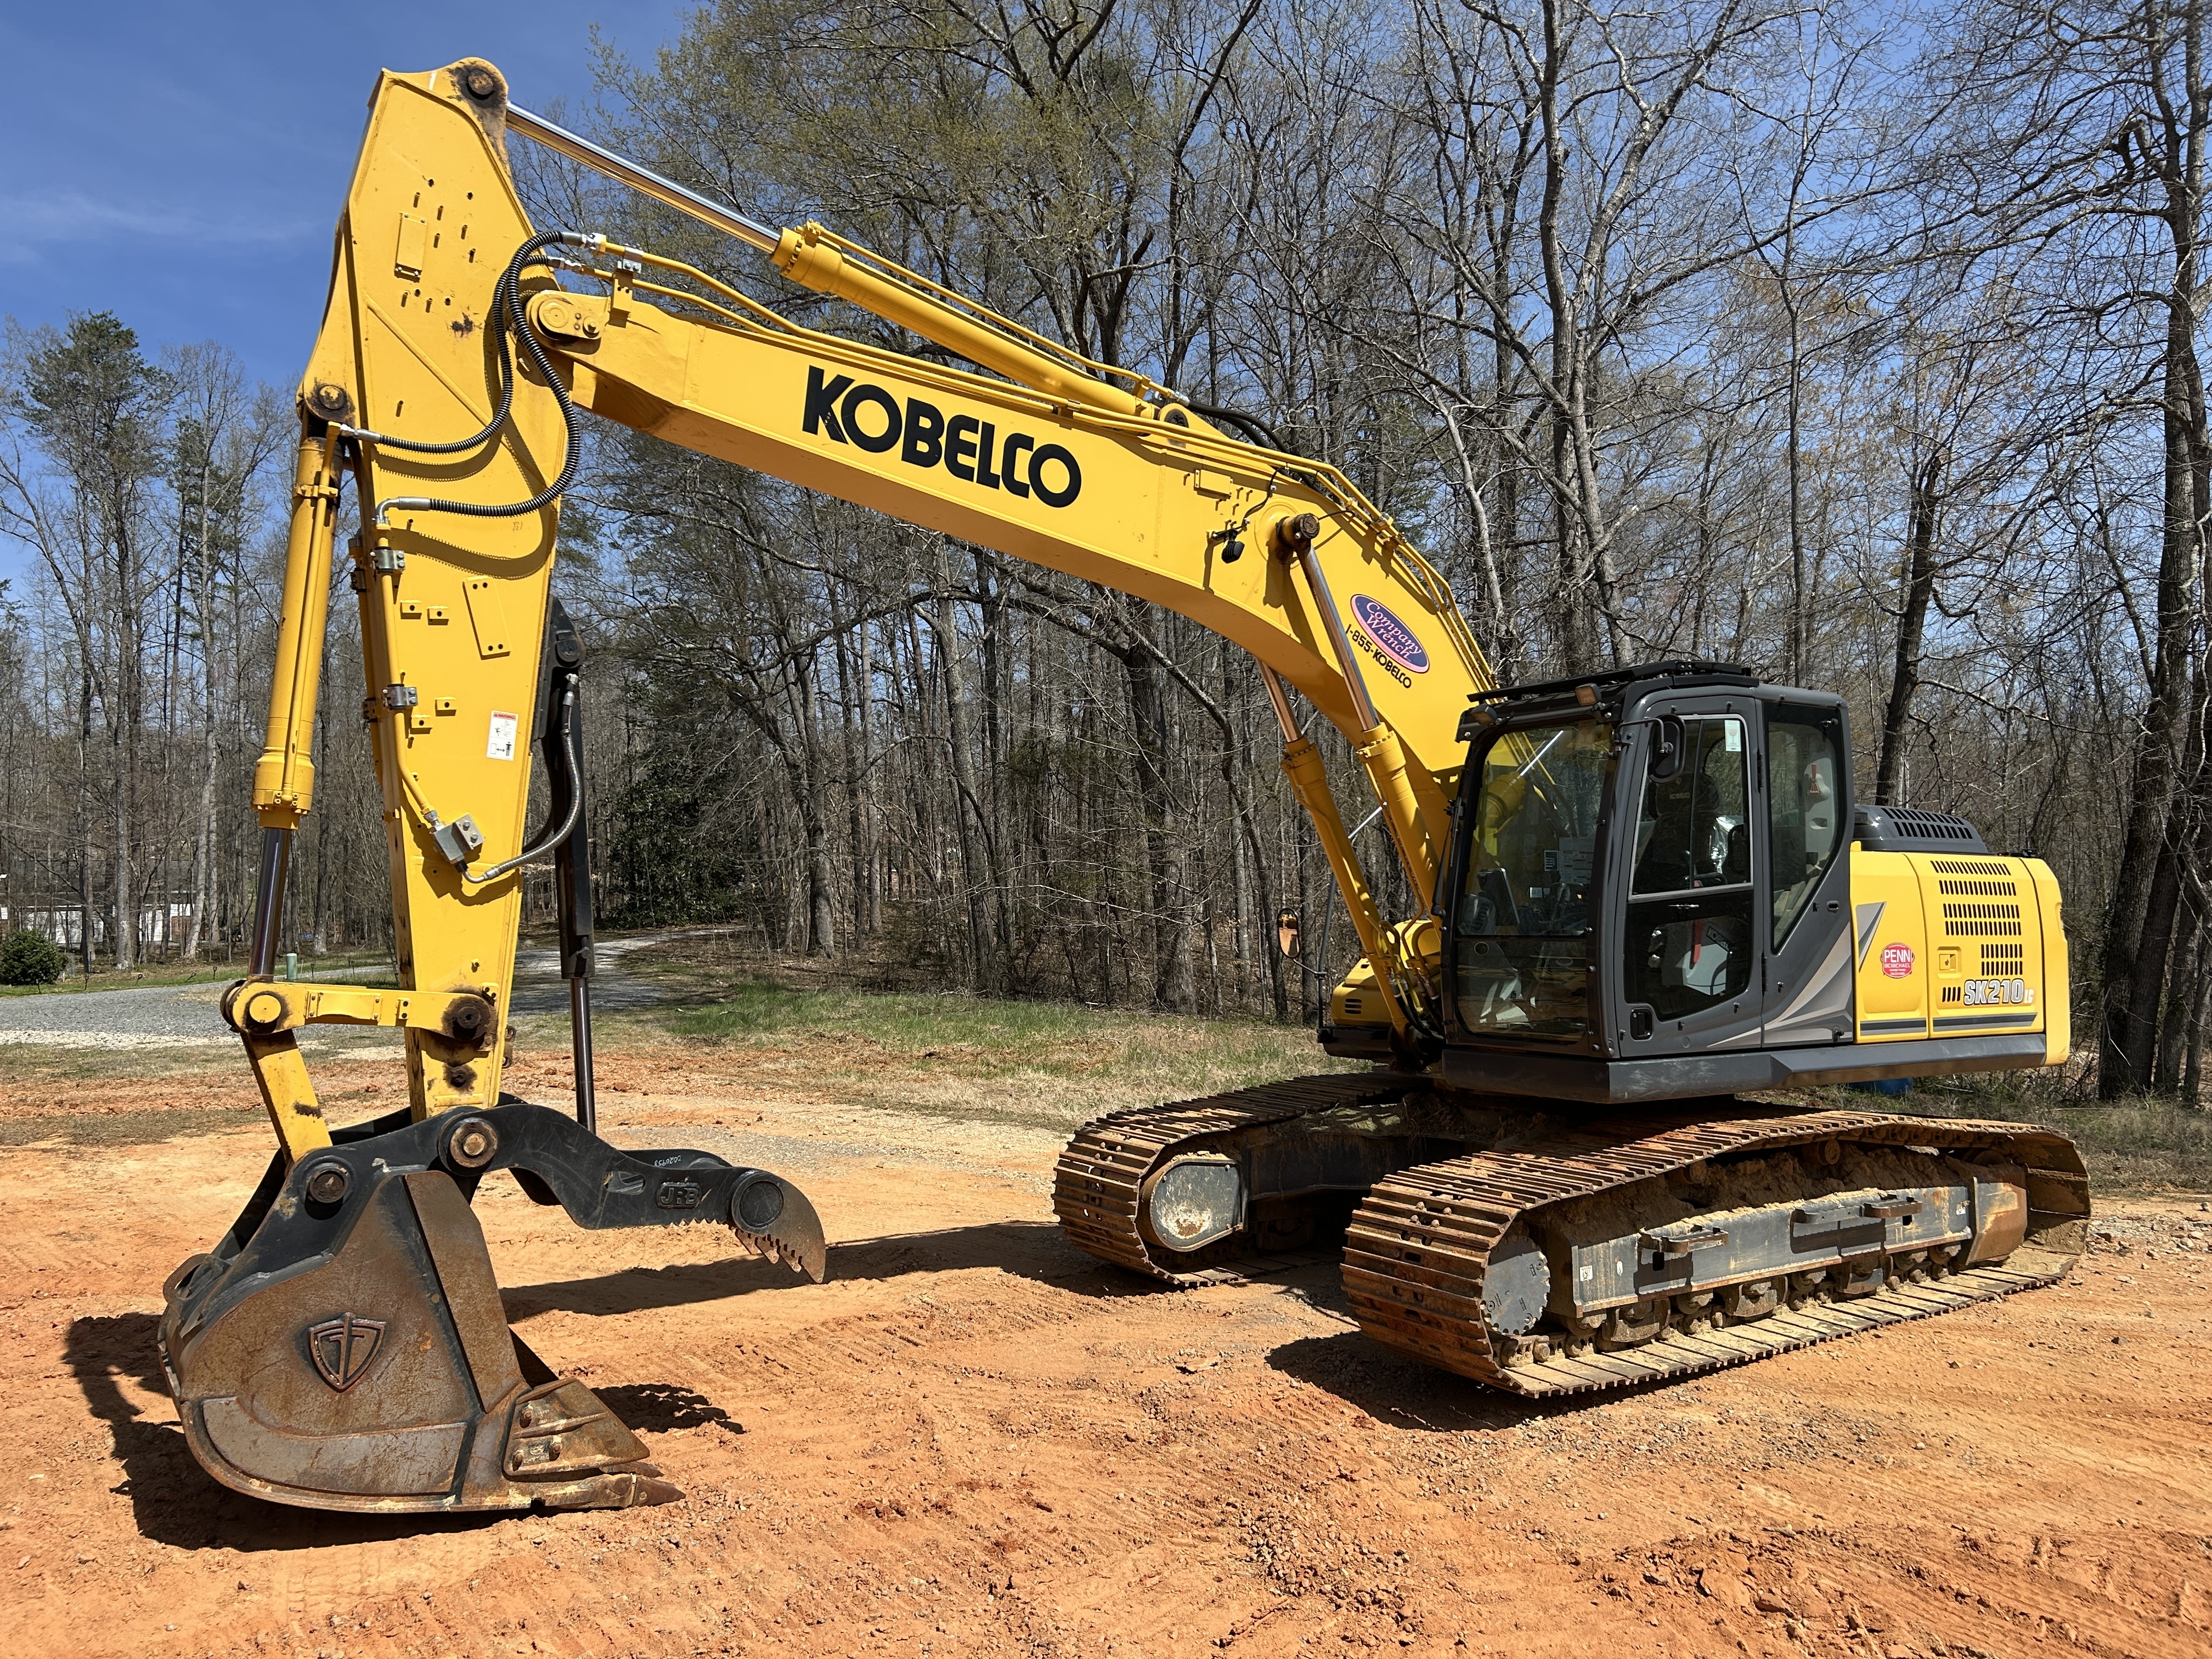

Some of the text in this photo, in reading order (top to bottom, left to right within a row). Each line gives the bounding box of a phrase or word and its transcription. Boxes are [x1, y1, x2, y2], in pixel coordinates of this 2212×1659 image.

[802, 365, 1082, 508] KOBELCO
[1366, 602, 1422, 654] Company
[1366, 614, 1410, 659] Wrench
[1346, 624, 1412, 689] 1-855-KOBELCO
[1884, 949, 1910, 963] PENN
[1963, 978, 2024, 1006] SK210
[661, 1187, 699, 1205] JRB
